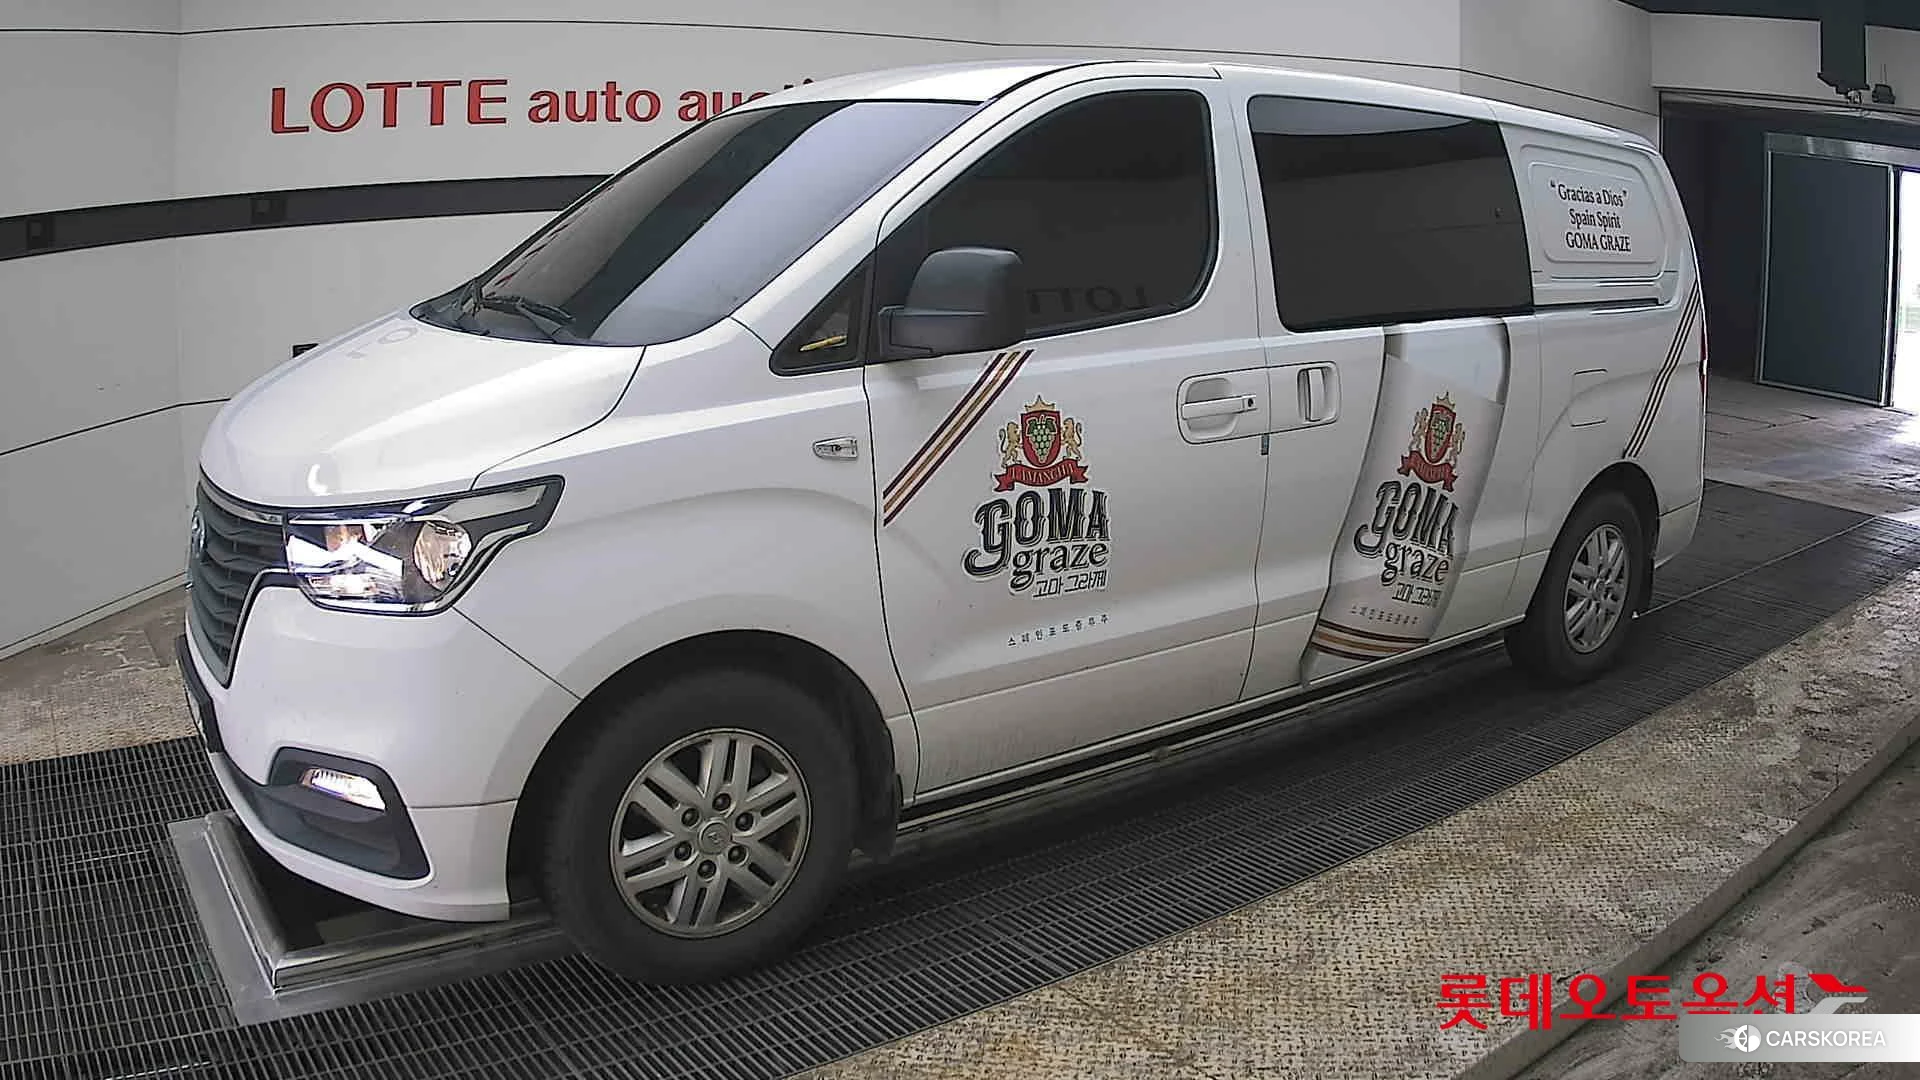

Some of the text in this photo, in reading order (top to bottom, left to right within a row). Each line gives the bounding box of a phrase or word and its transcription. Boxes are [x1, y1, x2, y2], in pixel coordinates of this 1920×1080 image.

[270, 79, 508, 134] LOTTE
[527, 81, 661, 124] auto
[1566, 232, 1632, 252] GOMA GRAZE
[1569, 208, 1621, 232] Spain Spirit
[963, 487, 1111, 576] GOMA
[1353, 480, 1459, 558] GOMA
[1009, 543, 1109, 593] graze
[1381, 542, 1449, 587] graze
